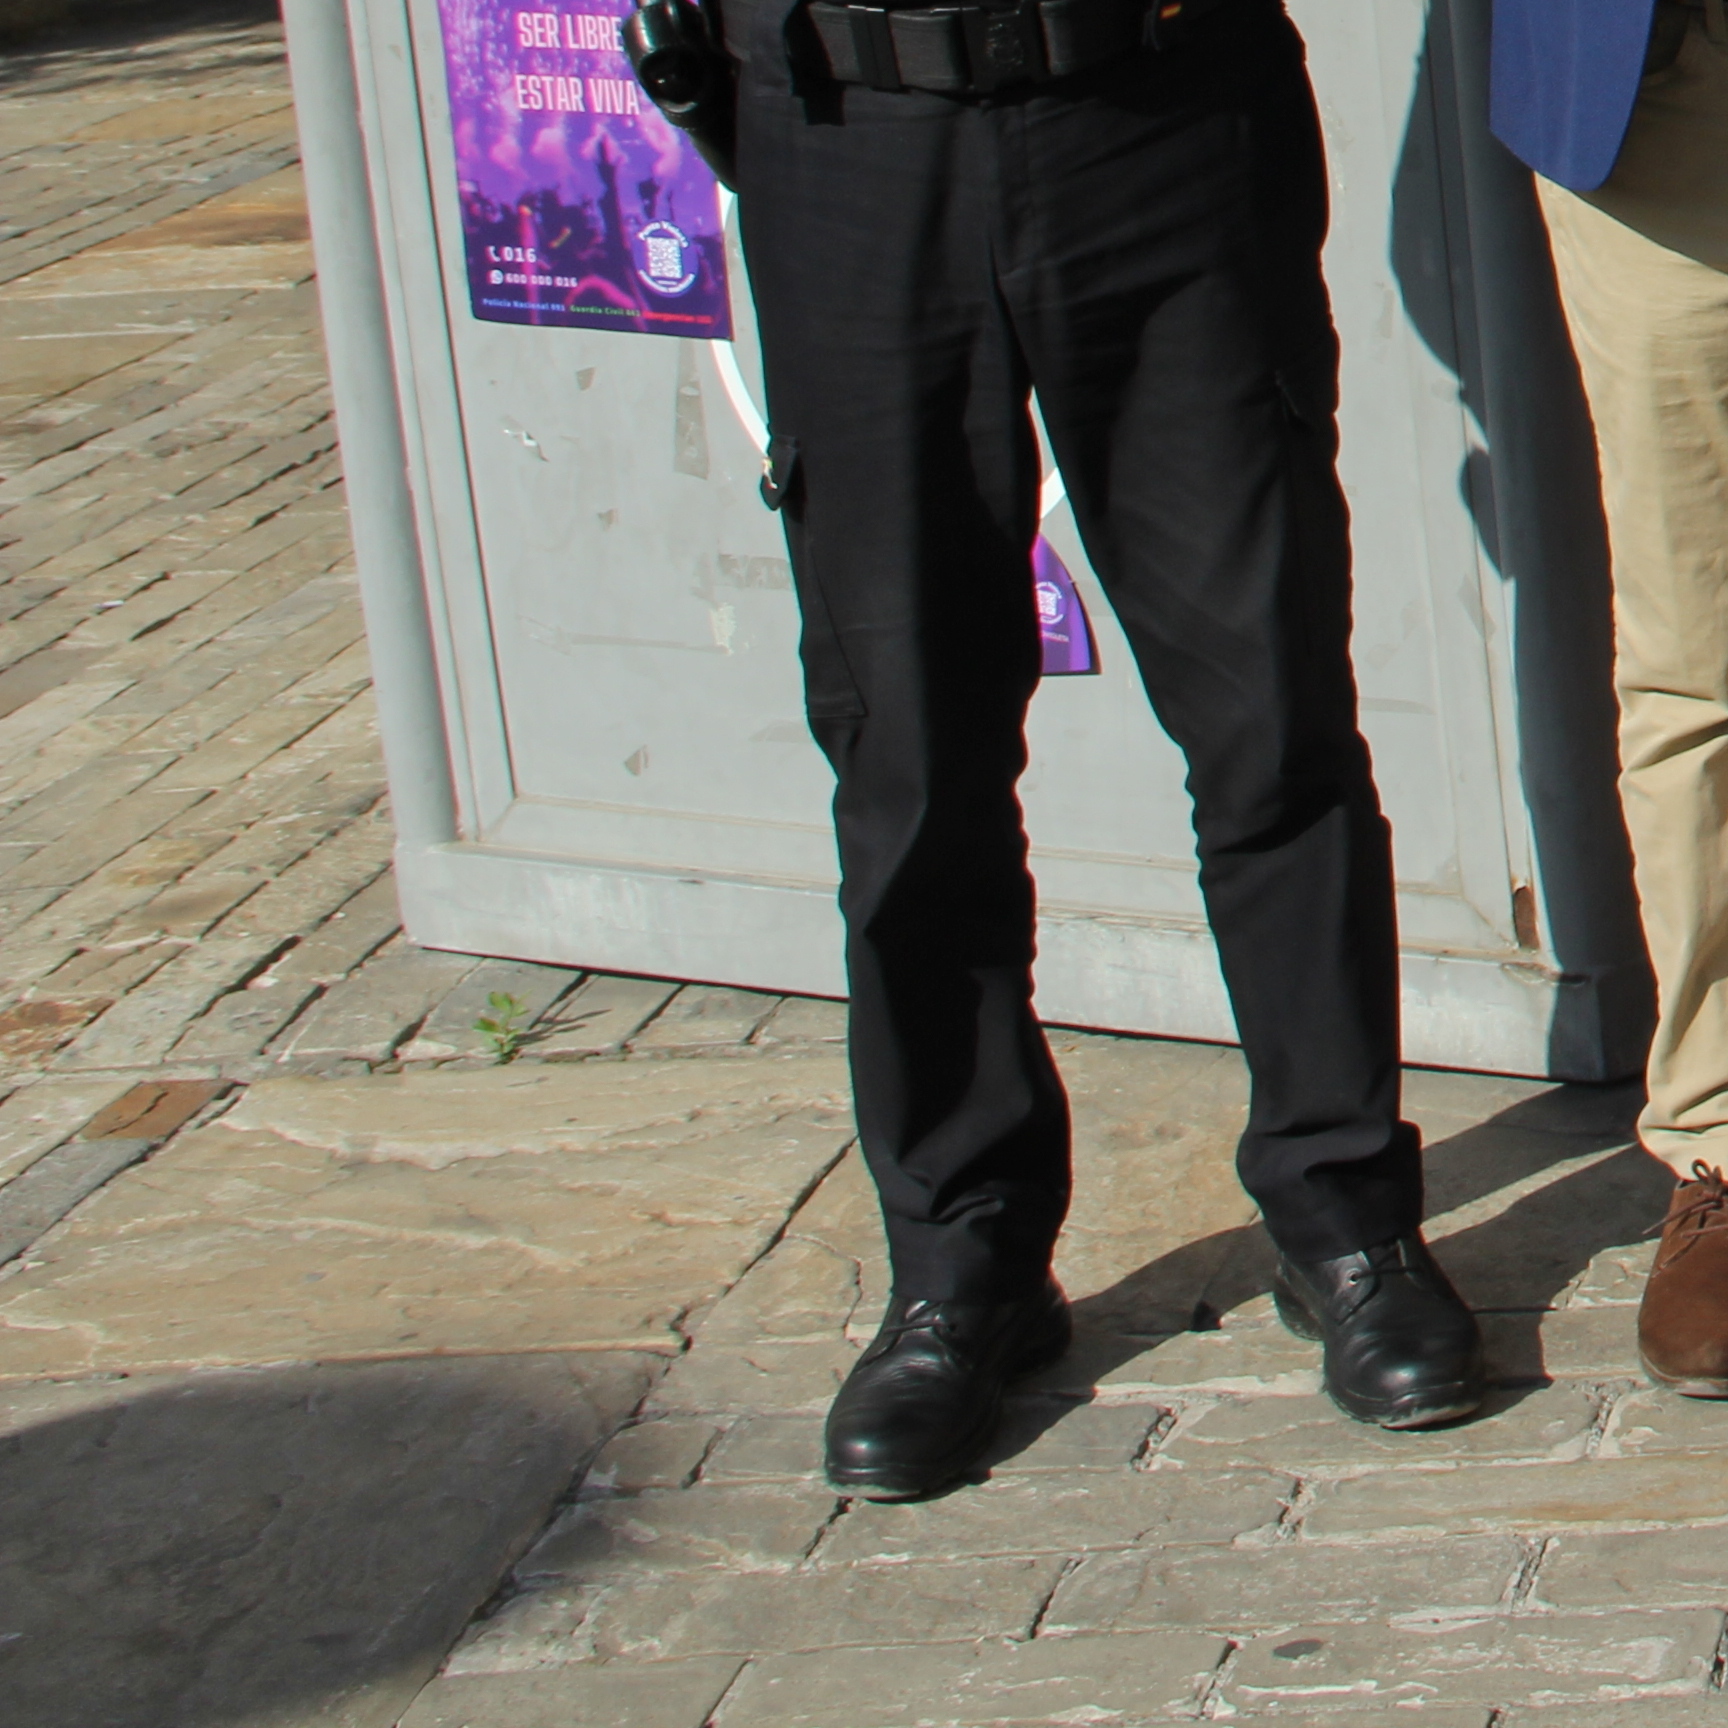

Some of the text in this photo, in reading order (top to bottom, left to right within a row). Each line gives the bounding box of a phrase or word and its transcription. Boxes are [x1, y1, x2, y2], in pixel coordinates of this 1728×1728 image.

[518, 12, 625, 52] SER LIBRE
[517, 74, 641, 115] ESTAR VIVA
[501, 246, 537, 263] 016
[505, 272, 578, 288] 600 000 016
